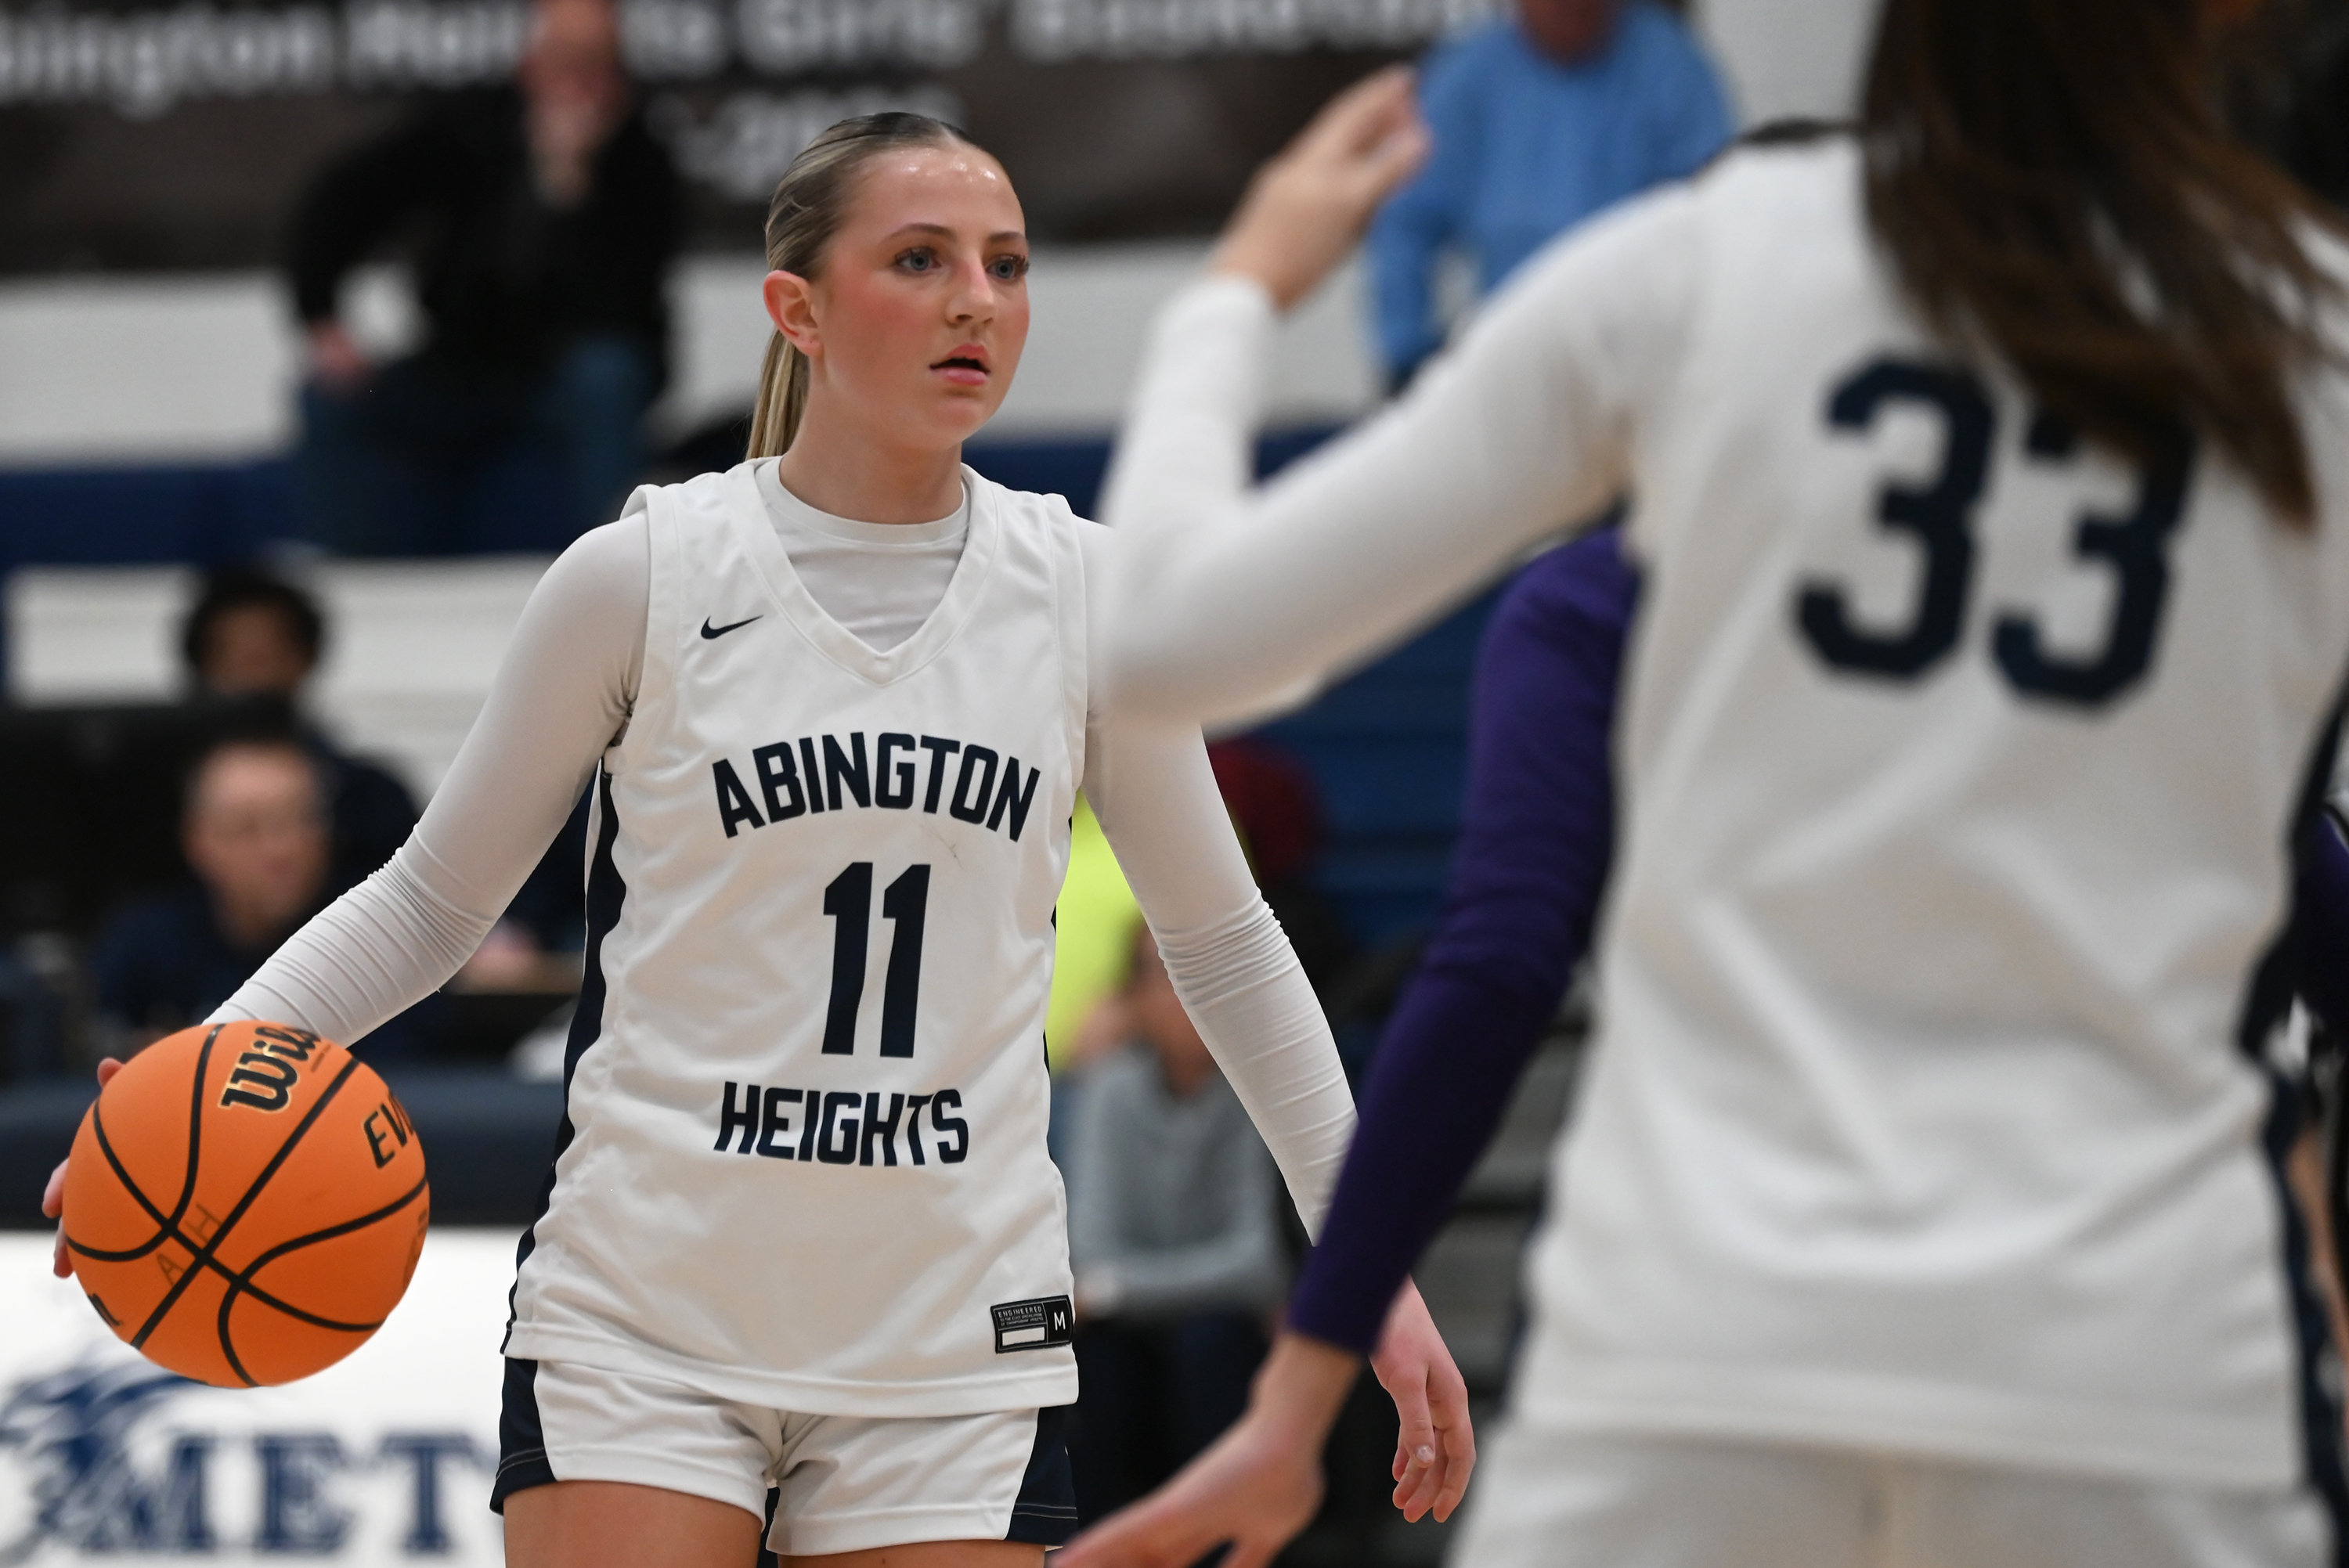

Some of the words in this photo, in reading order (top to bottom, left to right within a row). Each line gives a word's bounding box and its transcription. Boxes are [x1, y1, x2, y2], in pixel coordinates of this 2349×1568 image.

[1793, 356, 2196, 708] 33
[712, 731, 1041, 842] ABINGTON
[821, 862, 931, 1058] 11
[713, 1081, 969, 1167] HEIGHTS
[998, 1306, 1042, 1318] ENGINEERED
[1053, 1311, 1066, 1331] M
